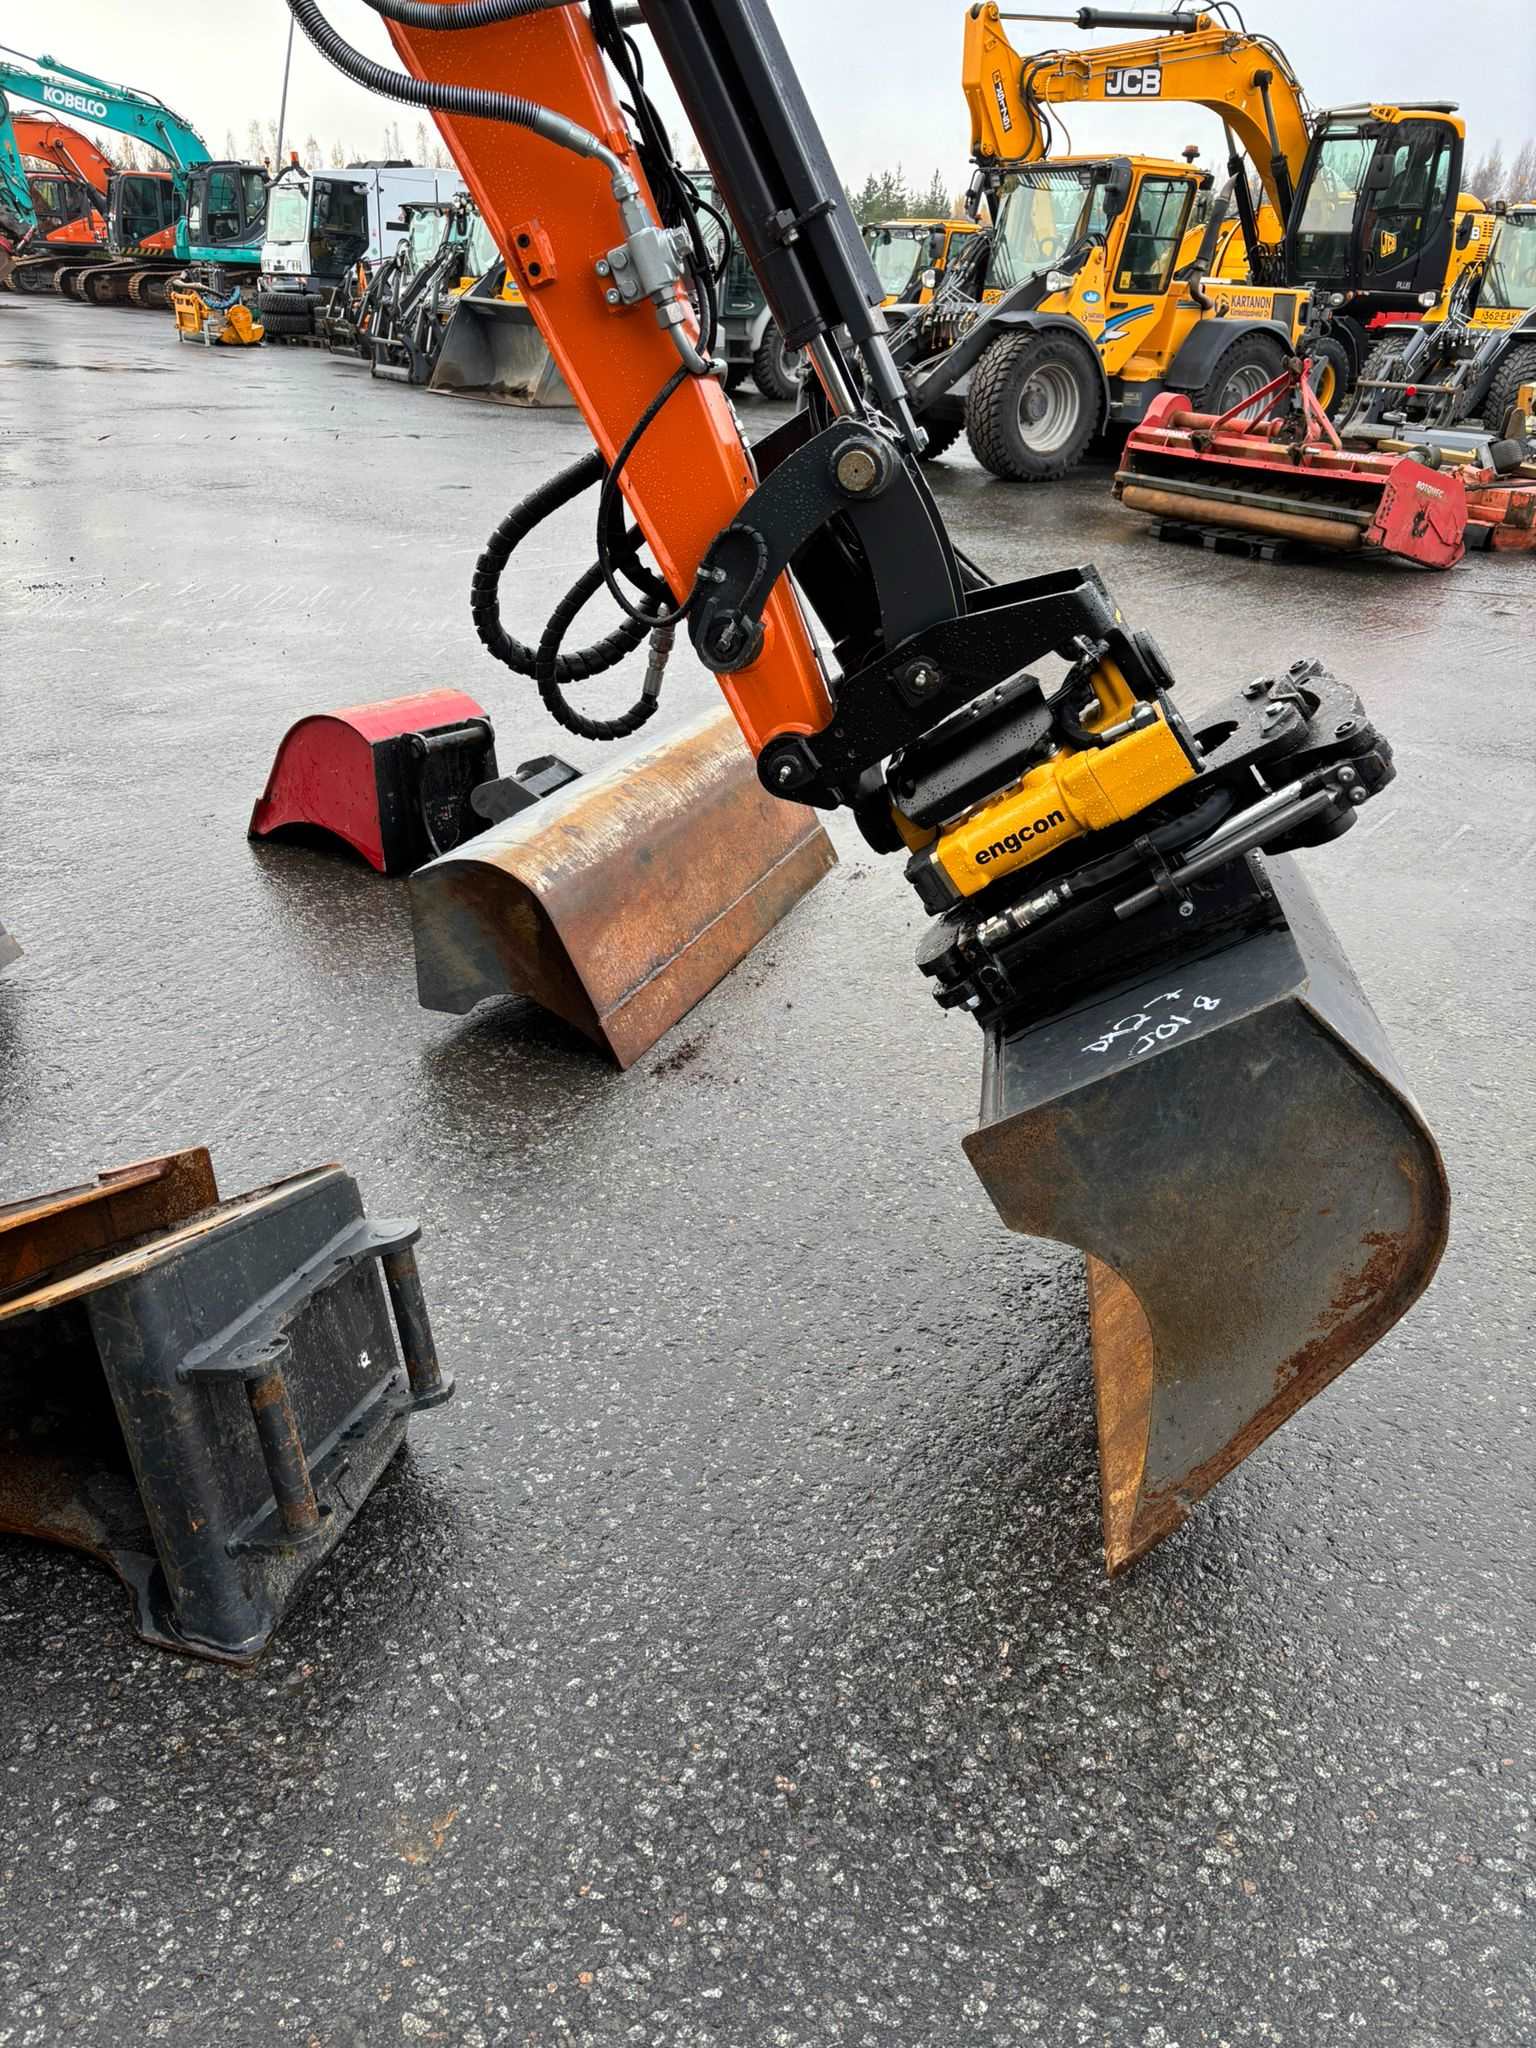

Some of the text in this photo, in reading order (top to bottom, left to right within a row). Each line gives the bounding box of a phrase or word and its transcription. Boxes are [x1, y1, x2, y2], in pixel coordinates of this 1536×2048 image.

[1105, 68, 1161, 95] JCB
[43, 84, 108, 119] KOBELCO
[1231, 294, 1271, 308] KARTANON
[975, 809, 1066, 865] engcon
